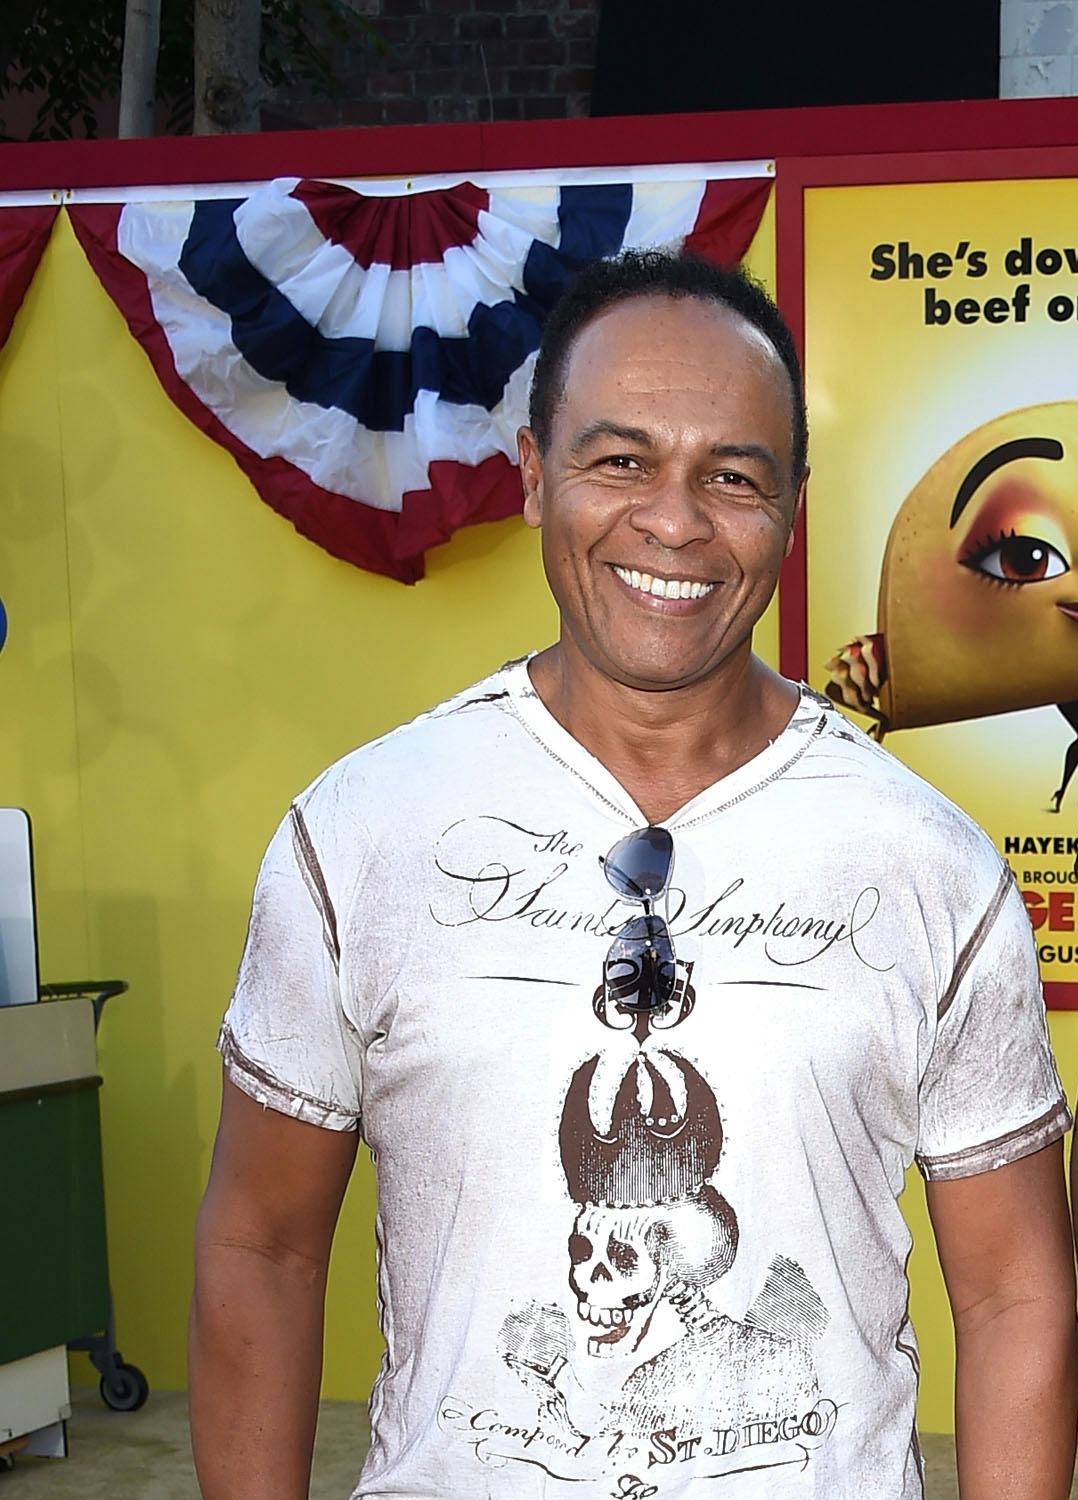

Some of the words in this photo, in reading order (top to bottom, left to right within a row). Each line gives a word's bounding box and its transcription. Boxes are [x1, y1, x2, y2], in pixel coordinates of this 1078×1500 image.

[870, 241, 988, 280] She's
[925, 284, 1031, 325] beef
[1020, 890, 1076, 932] GE
